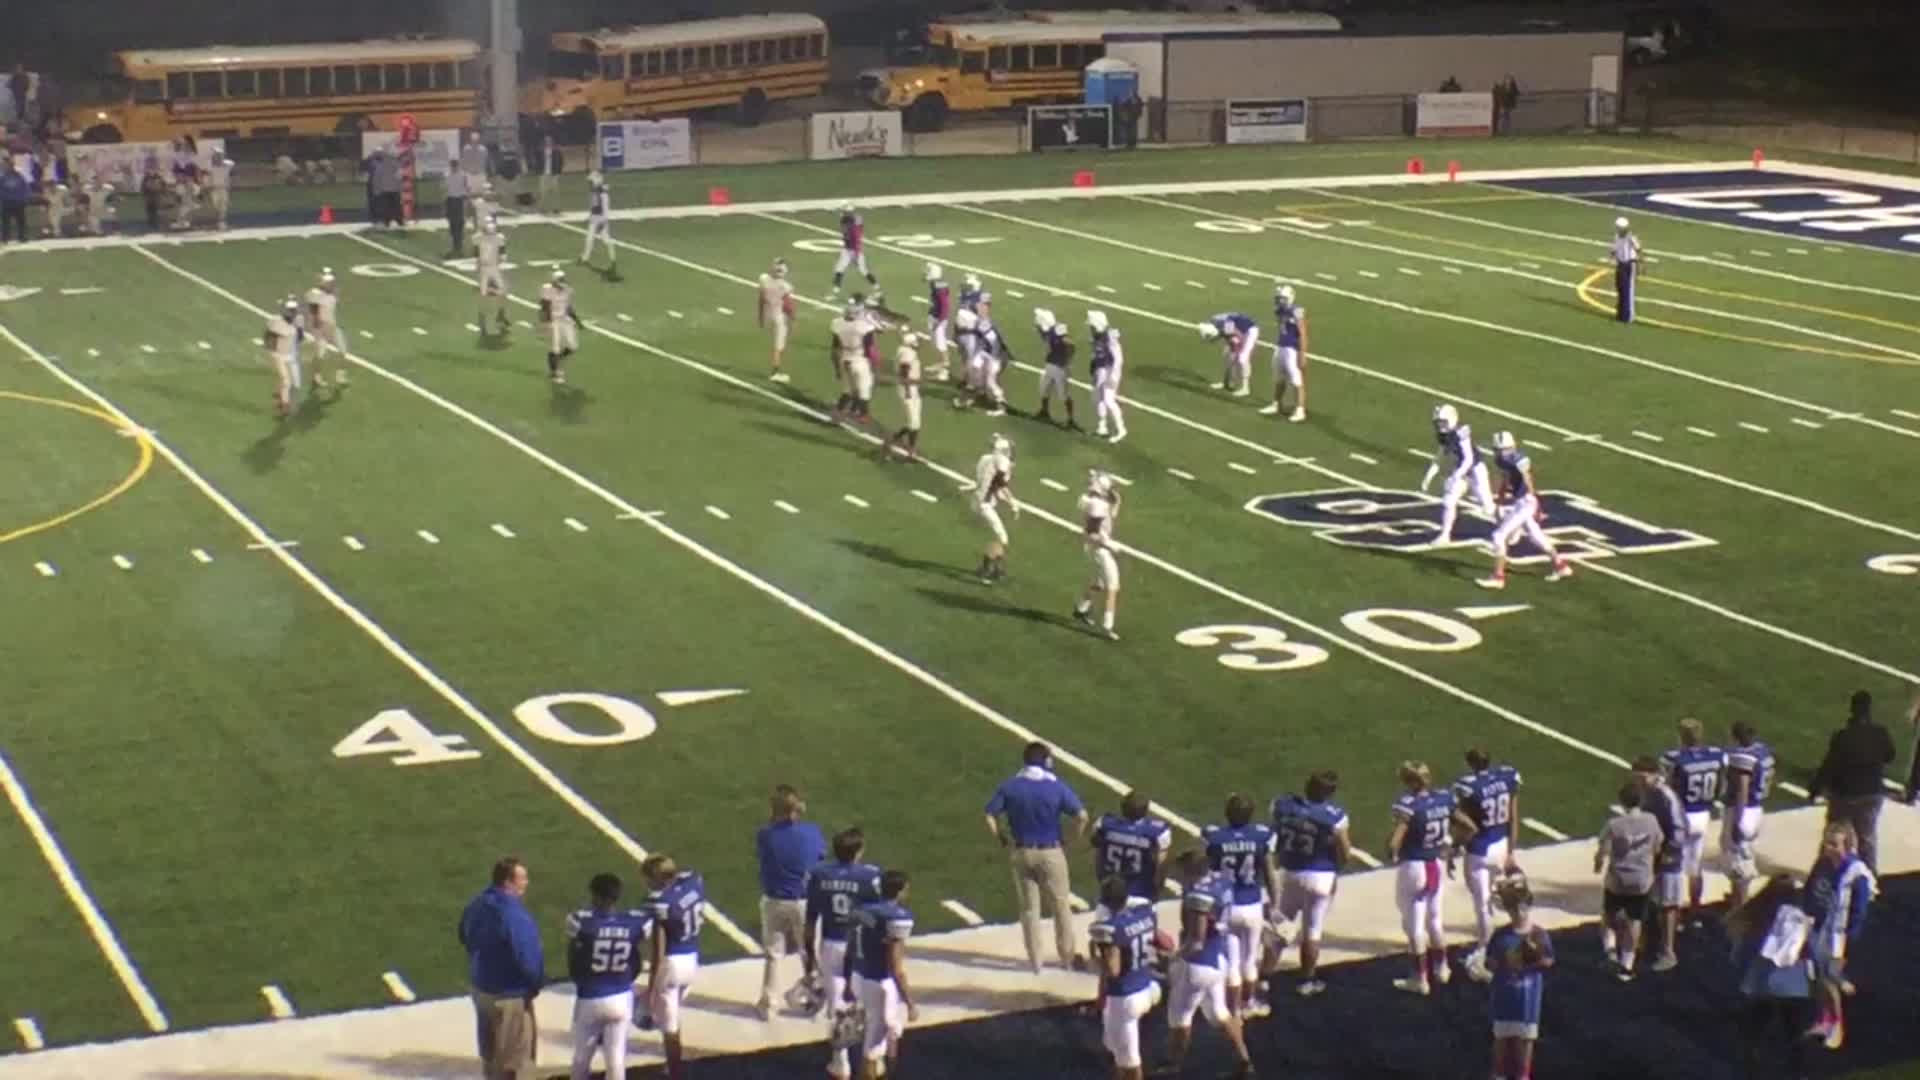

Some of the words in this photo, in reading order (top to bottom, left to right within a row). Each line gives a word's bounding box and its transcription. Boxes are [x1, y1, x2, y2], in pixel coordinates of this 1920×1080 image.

[1174, 606, 1483, 672] 30
[331, 691, 658, 766] 40
[1480, 792, 1511, 827] 38
[591, 939, 633, 974] 52
